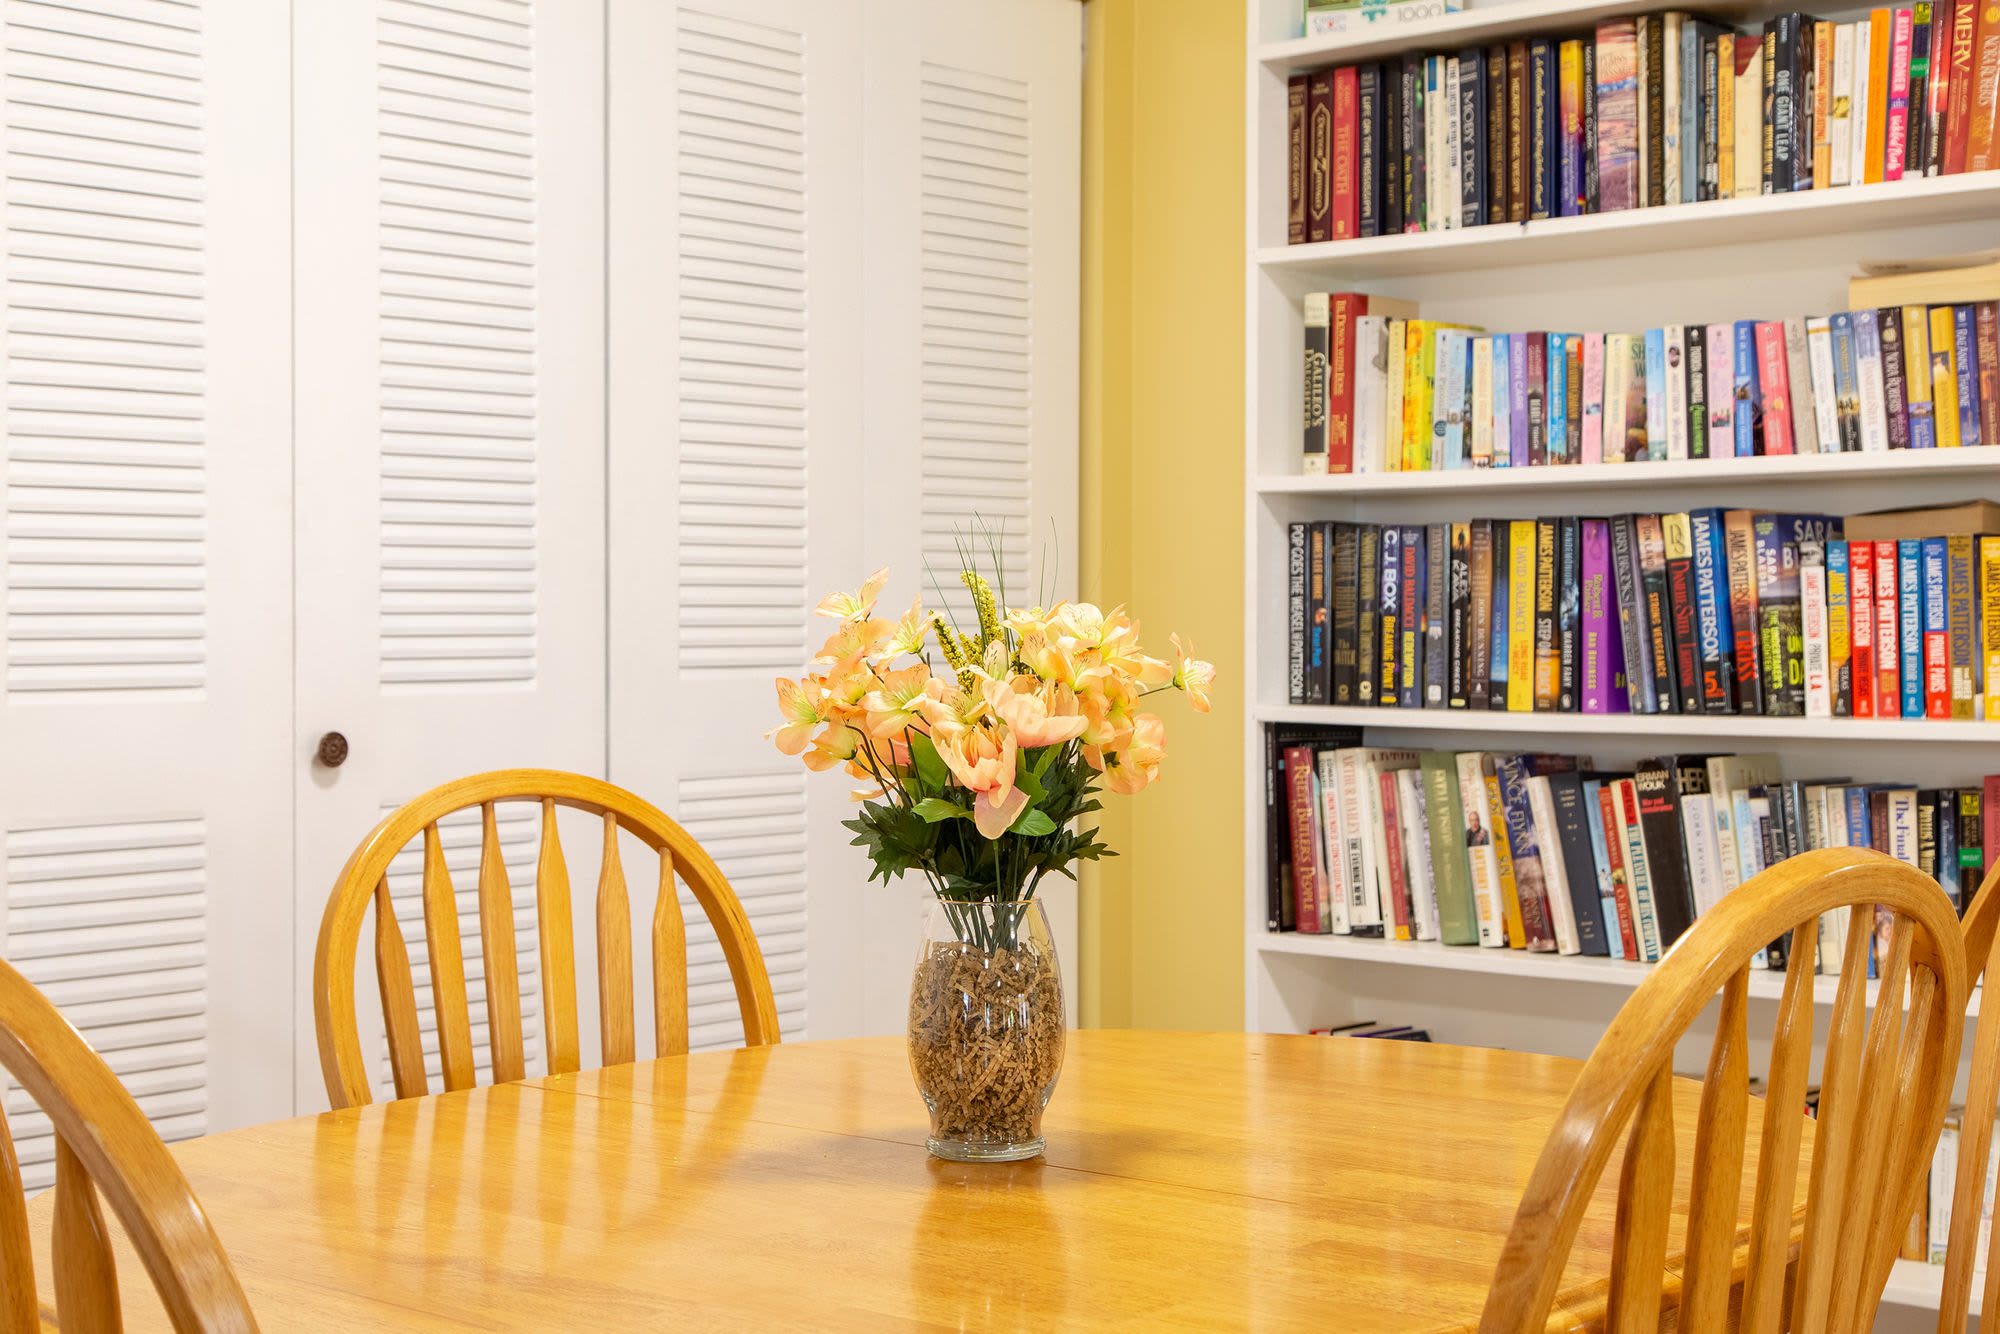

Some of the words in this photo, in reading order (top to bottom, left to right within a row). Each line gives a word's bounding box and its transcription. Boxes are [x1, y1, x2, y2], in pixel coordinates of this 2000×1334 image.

[1895, 17, 1909, 43] RITA
[1953, 3, 1974, 71] MERV
[1980, 35, 2000, 65] NORA
[1776, 70, 1790, 93] ONE
[1893, 45, 1908, 93] RUDNER
[1978, 66, 1998, 107] ROBERTS
[1362, 95, 1372, 117] LIFE
[1462, 90, 1475, 143] MOBY
[1776, 96, 1789, 130] GIANT
[1337, 123, 1350, 151] THE
[1362, 118, 1371, 134] ON
[1403, 117, 1411, 151] CARR
[1512, 118, 1520, 133] OF
[1292, 147, 1301, 168] GOOD
[1362, 135, 1371, 155] THE
[1512, 135, 1521, 159] THE
[1776, 133, 1788, 161] LEAP
[1336, 155, 1349, 194] OATH
[1361, 157, 1371, 218] MISSISSIPPI
[1462, 148, 1476, 196] DICK
[1512, 160, 1521, 193] WEST
[1514, 341, 1524, 378] ROBYN
[1885, 352, 1900, 376] NORA
[1310, 352, 1326, 428] GALILEO'S
[1514, 380, 1525, 411] CARR
[1884, 377, 1902, 414] ROBERTS
[1290, 525, 1304, 546] POP
[1383, 529, 1398, 547] C.
[1431, 528, 1443, 561] DAVID
[1539, 522, 1554, 556] JAMES
[1614, 520, 1631, 557] TERRY
[1693, 516, 1713, 568] JAMES
[1729, 529, 1746, 560] JAMES
[1290, 548, 1304, 574] GOES
[1383, 550, 1397, 565] J.
[1403, 546, 1416, 577] DAVID
[1515, 545, 1529, 578] DAVID
[1756, 539, 1767, 594] BLAEDEL
[1766, 548, 1779, 585] SARA
[1902, 557, 1918, 592] JAMES
[1926, 556, 1943, 584] JAMES
[1951, 554, 1969, 594] JAMES
[1290, 575, 1304, 595] THE
[1383, 568, 1397, 610] BOX
[1431, 564, 1443, 620] BALDACCI
[1451, 559, 1460, 604] KAVA
[1459, 561, 1468, 598] ALEX
[1538, 556, 1553, 612] PATTERSON
[1671, 561, 1691, 606] DANIELLE
[1731, 559, 1751, 617] PATTERSON
[1828, 569, 1846, 604] JAMES
[1852, 566, 1869, 597] JAMES
[1878, 557, 1895, 598] JAMES
[1985, 559, 2000, 594] JAMES
[1290, 596, 1304, 633] WEASEL
[1403, 578, 1416, 628] BALDACCI
[1477, 598, 1486, 625] JOHN
[1514, 581, 1528, 633] BALDACCI
[1649, 592, 1661, 625] STRONG
[1674, 605, 1695, 638] STEEL
[1697, 568, 1720, 662] PATTERSON
[1928, 584, 1945, 630] PATTERSON
[1454, 608, 1462, 658] BREAKING
[1538, 618, 1552, 641] STEP
[1829, 604, 1849, 658] PATTERSON
[1853, 597, 1871, 647] PATTERSON
[1879, 599, 1897, 669] PATTERSON
[1903, 593, 1920, 653] PATTERSON
[1952, 597, 1972, 667] PATTERSON
[1986, 595, 2000, 652] PATTERSON
[1403, 631, 1414, 688] REDEMPTION
[1476, 627, 1486, 677] DUNNING
[1563, 630, 1573, 665] WARREN
[1653, 626, 1667, 678] VENGEANCE
[1679, 642, 1697, 689] LIGHTNING
[1735, 630, 1758, 682] CROSS
[1762, 628, 1773, 672] DAUGHTER
[1771, 626, 1784, 690] UNDERTAKER'S
[1929, 634, 1945, 667] PRIVATE
[1290, 641, 1304, 698] PATTERSON
[1454, 659, 1462, 694] CREED
[1562, 666, 1573, 688] FAHY
[1841, 664, 1849, 691] TEXAS
[1906, 681, 1918, 695] #3
[1930, 667, 1946, 693] PARIS
[1293, 764, 1311, 803] RHETT
[1342, 755, 1357, 794] ARTHUR
[1504, 757, 1525, 808] VINCE
[1346, 797, 1361, 835] HAILEY
[1784, 785, 1794, 814] JANE
[1895, 796, 1910, 824] The
[1296, 807, 1313, 864] BUTLER'S
[1509, 809, 1531, 857] FLYNN
[1692, 807, 1703, 838] JOHN
[1722, 836, 1732, 862] TALL
[1896, 826, 1911, 861] Final
[1351, 853, 1361, 883] EVENING
[1696, 842, 1707, 885] IRVING
[1300, 866, 1316, 913] PEOPLE
[1617, 902, 1630, 936] JULIET
